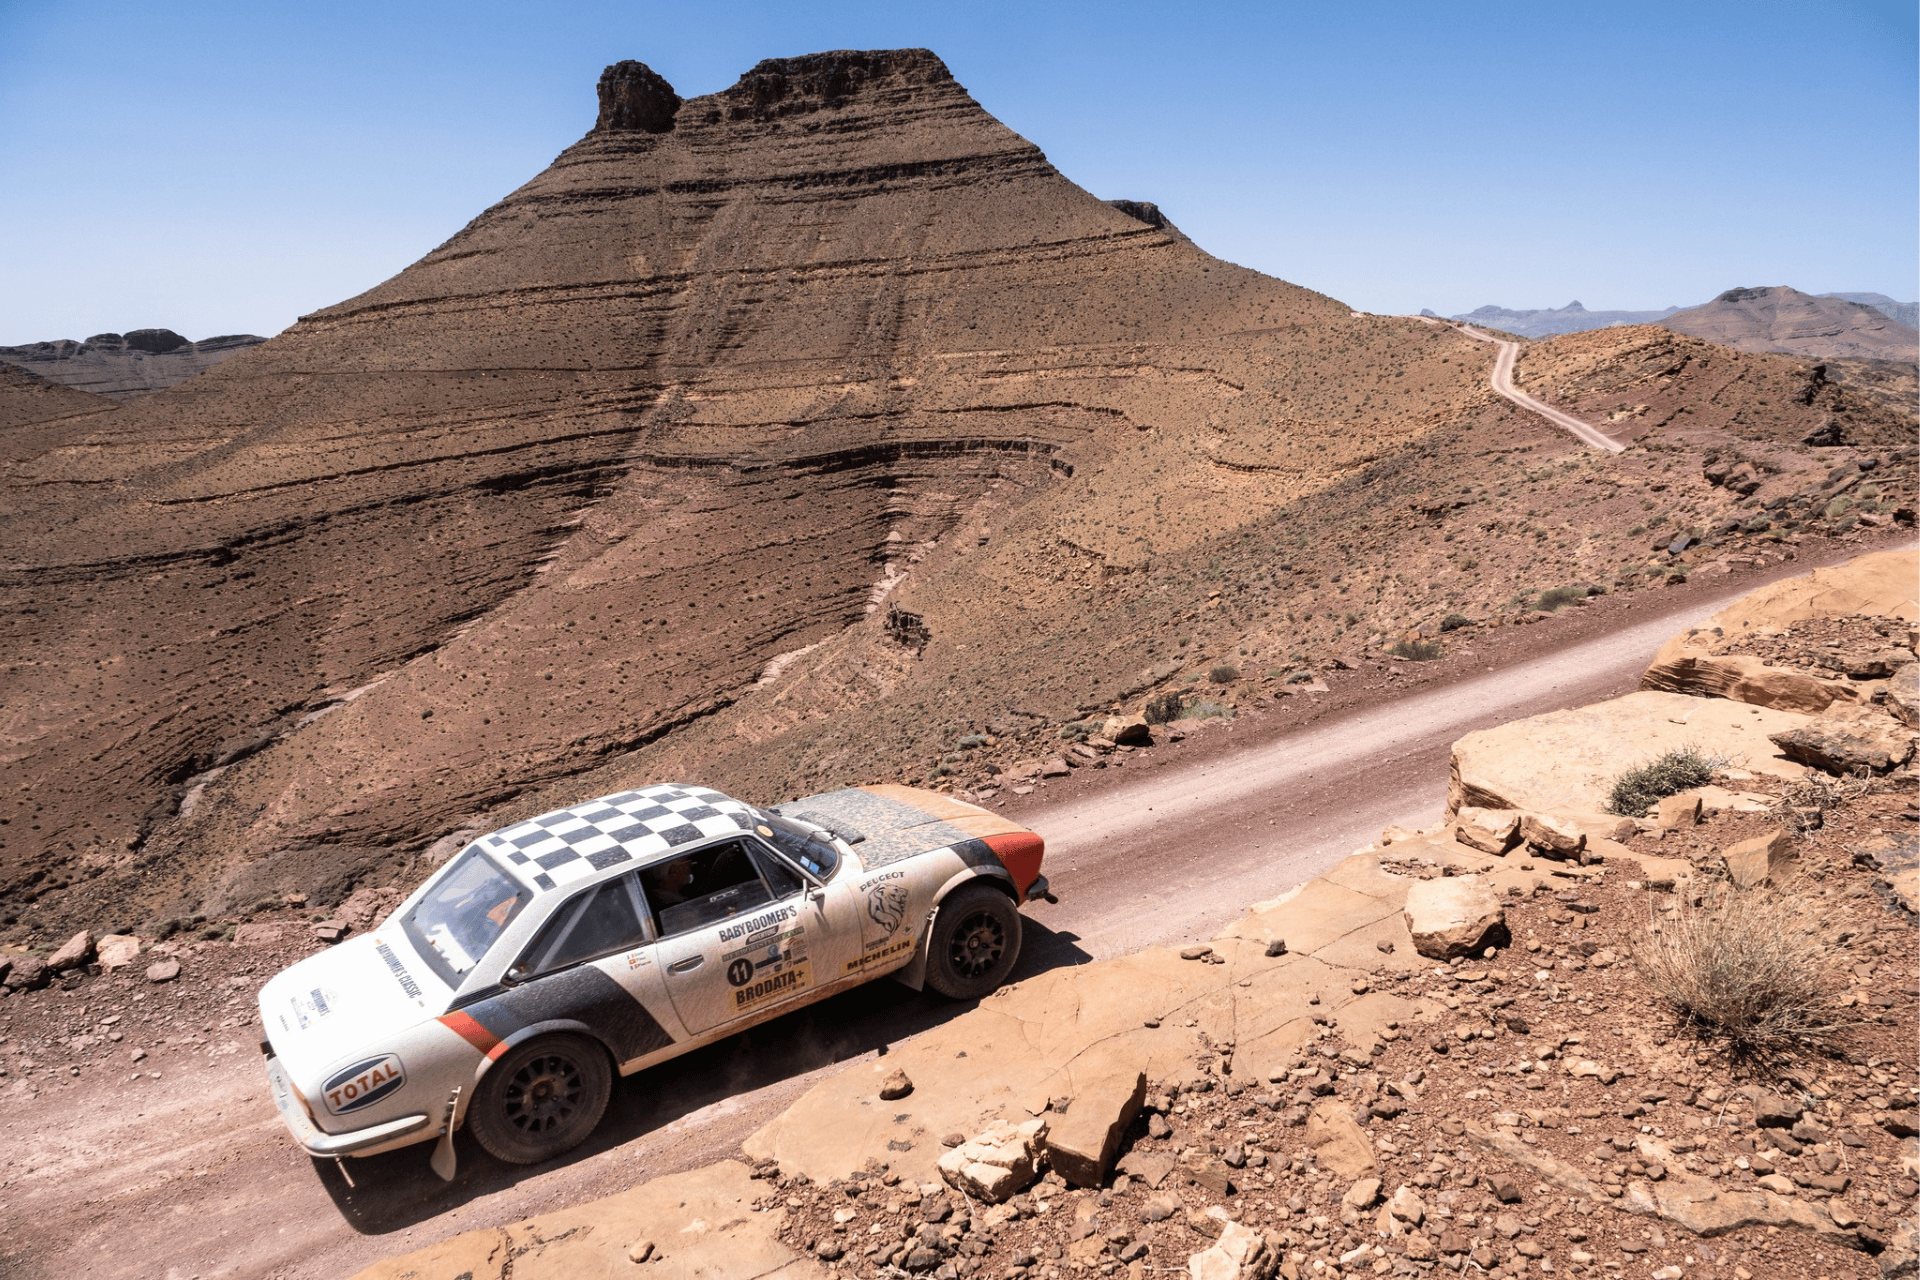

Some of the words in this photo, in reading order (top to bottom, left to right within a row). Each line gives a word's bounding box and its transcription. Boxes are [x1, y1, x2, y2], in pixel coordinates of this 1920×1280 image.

[859, 871, 905, 893] PEUGEOT
[718, 905, 797, 943] BABYBOOMER'S
[847, 940, 910, 970] MICHELIN
[732, 962, 749, 983] 11
[398, 974, 423, 999] CLASSIC
[329, 1063, 399, 1107] TOTAL
